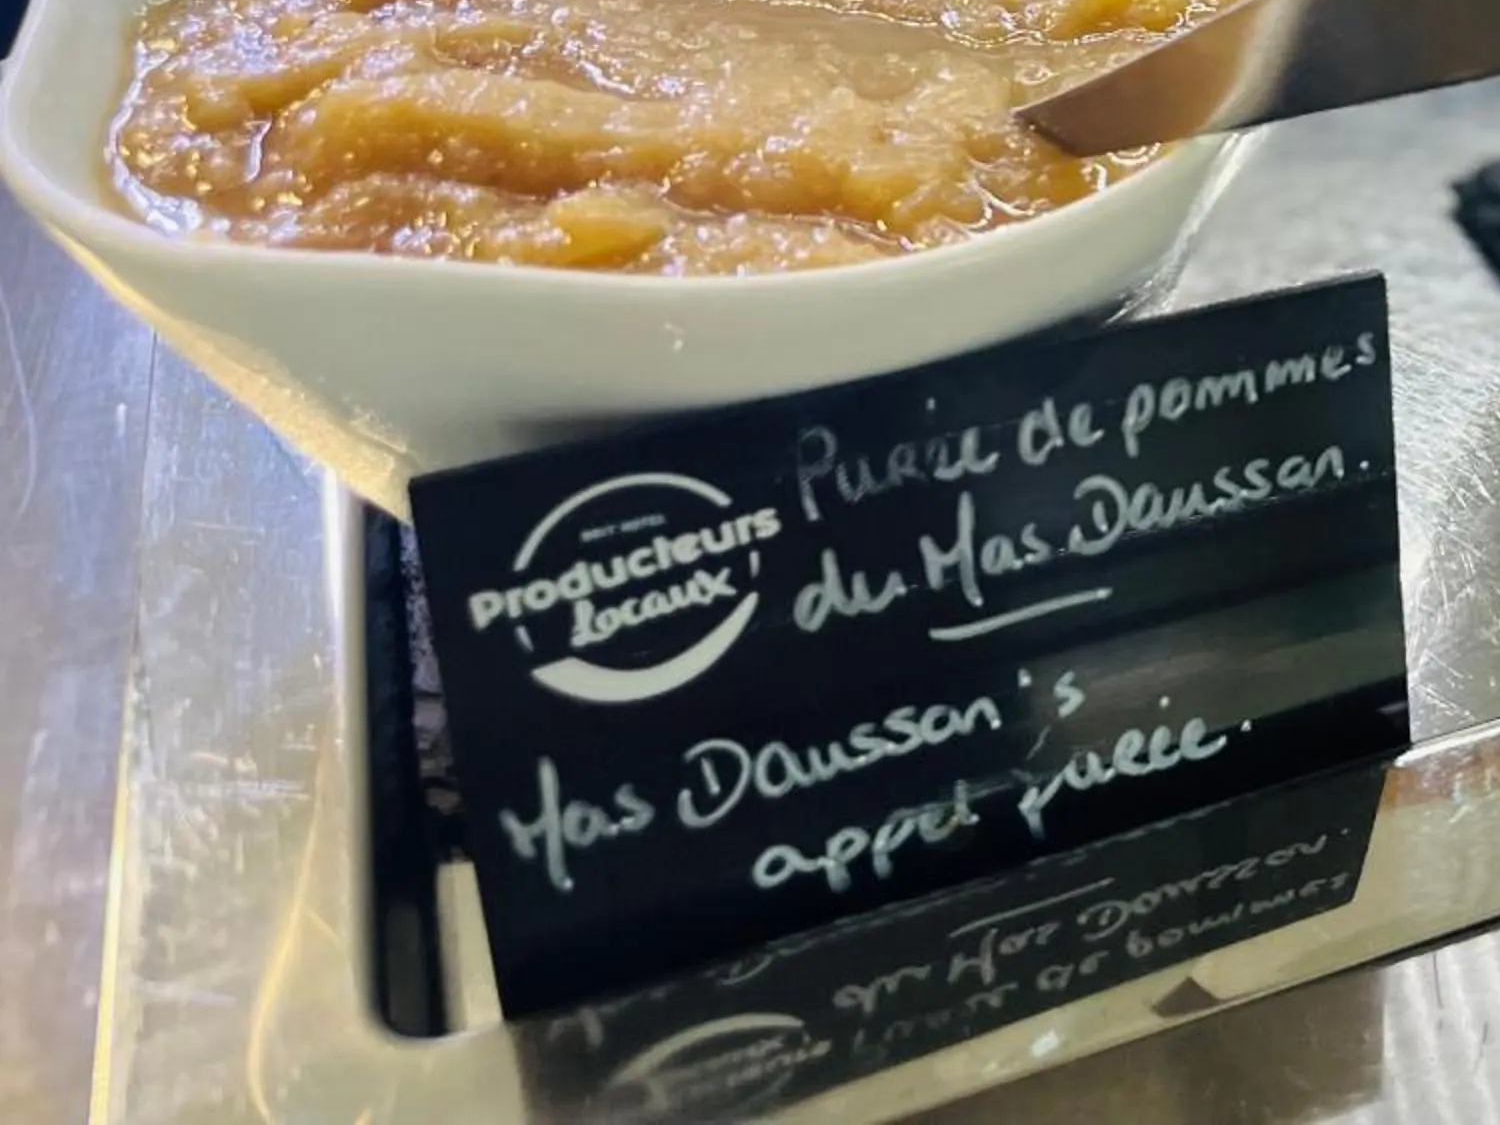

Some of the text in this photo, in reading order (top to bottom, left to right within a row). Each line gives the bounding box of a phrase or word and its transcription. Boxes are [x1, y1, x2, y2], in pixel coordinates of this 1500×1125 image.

[1017, 396, 1105, 466] de
[1123, 331, 1376, 457] pommes
[468, 506, 782, 632] Producteurs
[570, 566, 738, 649] Locaux
[793, 546, 907, 632] du
